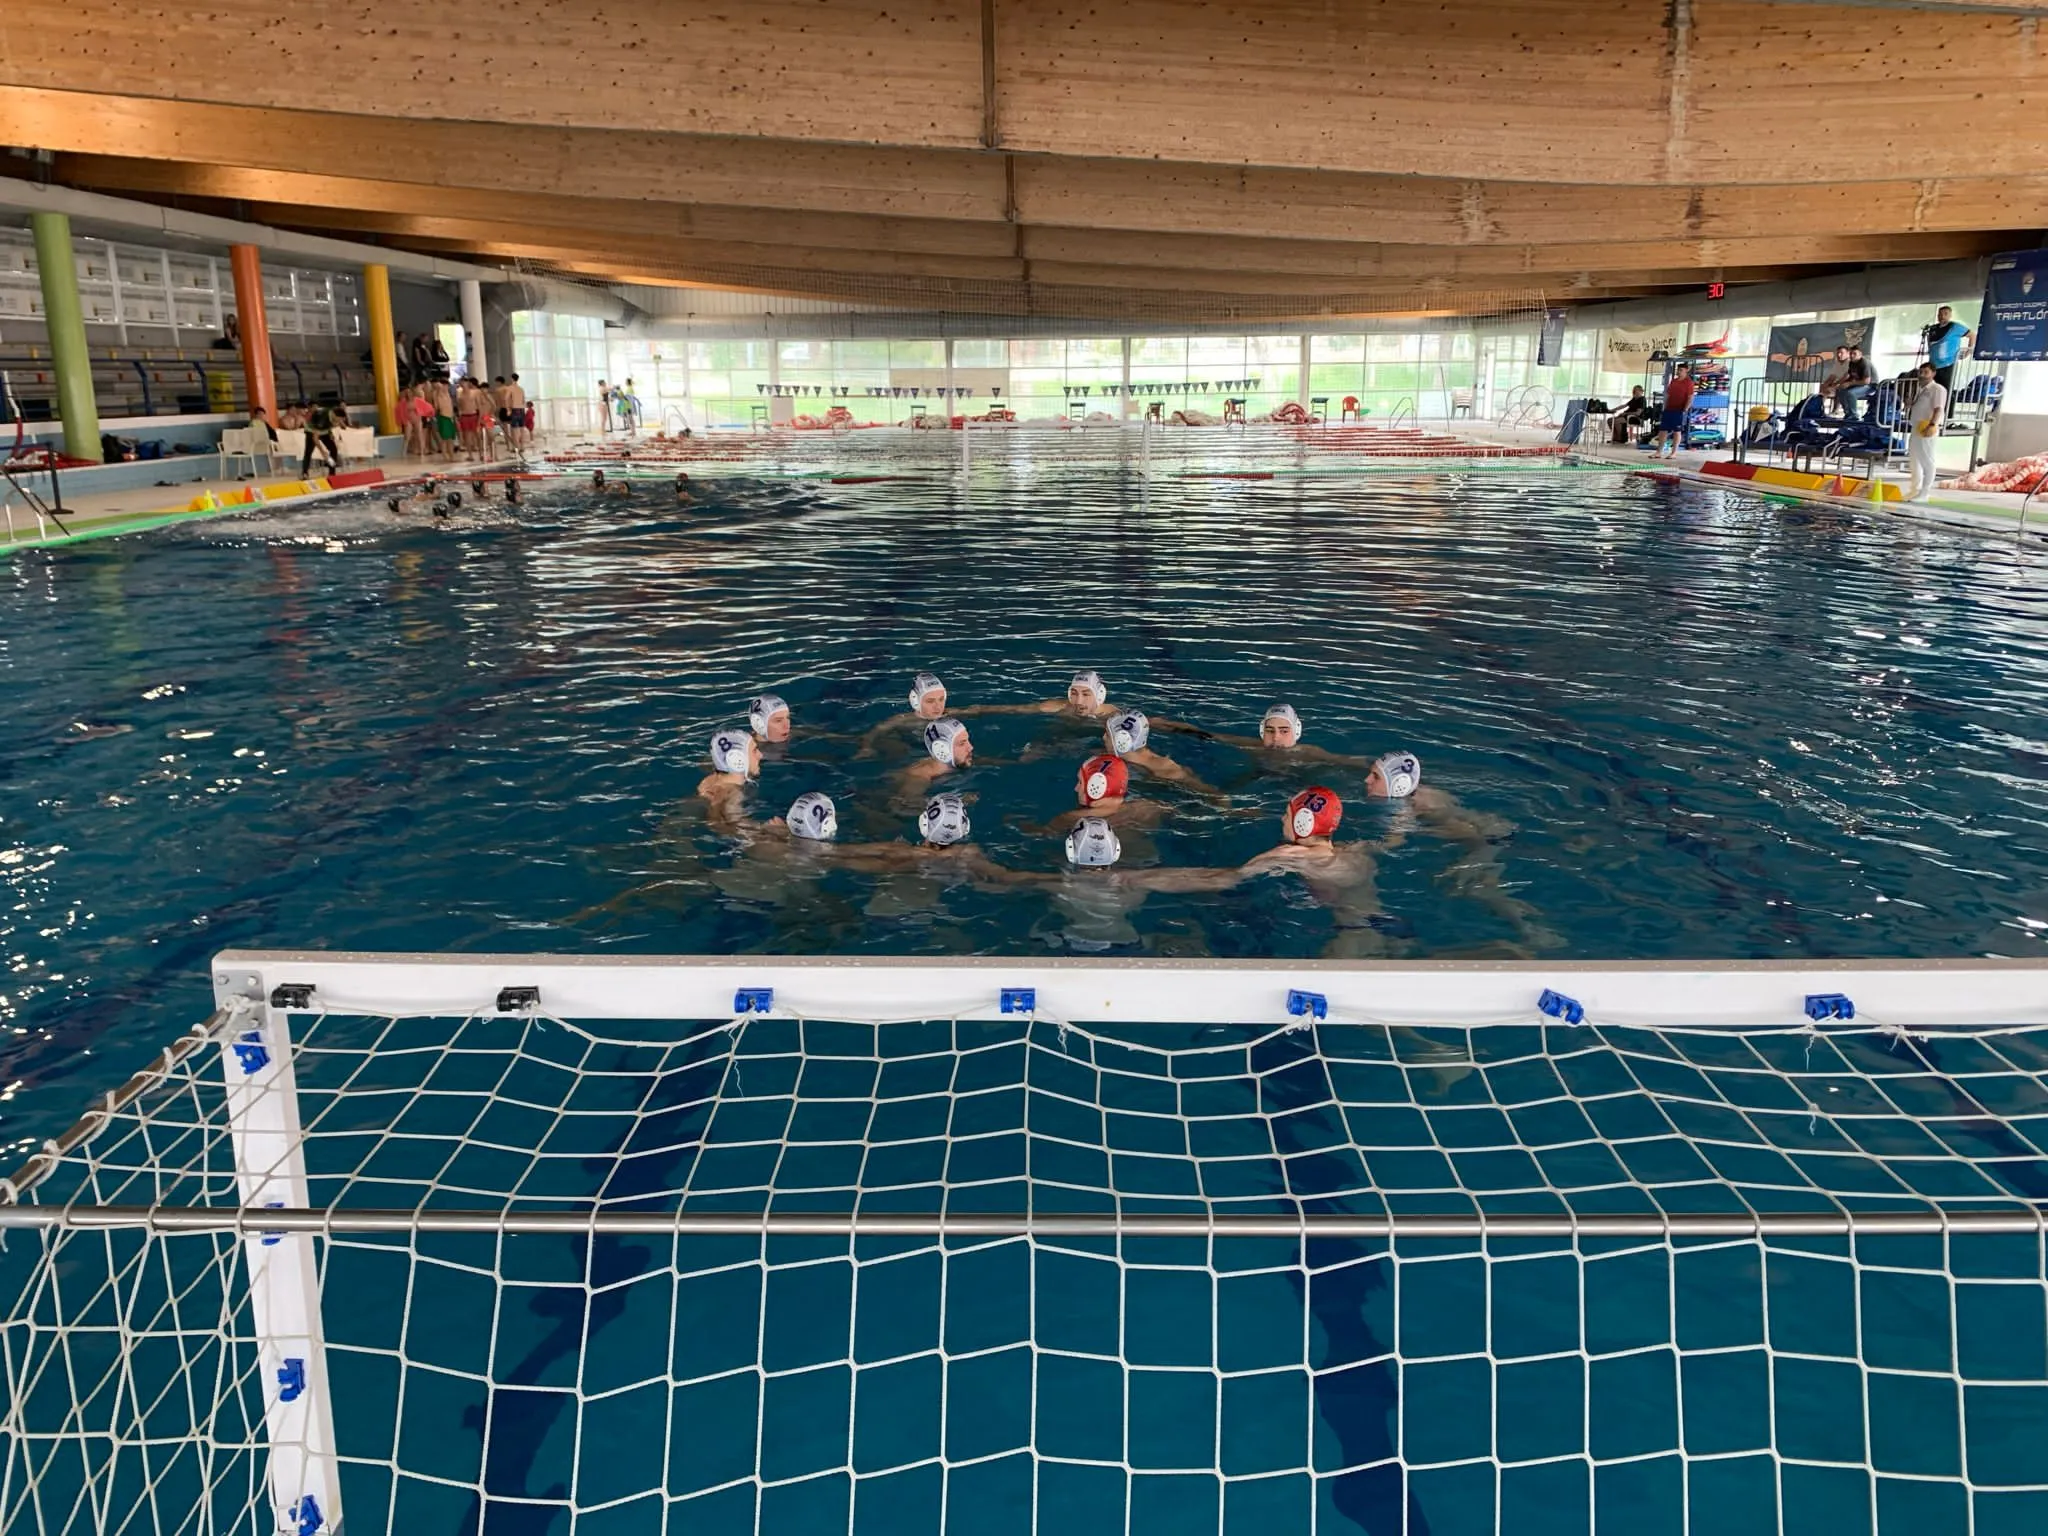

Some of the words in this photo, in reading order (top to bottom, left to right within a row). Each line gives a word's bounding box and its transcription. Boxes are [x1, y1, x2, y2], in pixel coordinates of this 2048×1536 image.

[1708, 283, 1724, 298] 30
[1121, 717, 1137, 731] 5
[926, 724, 941, 742] 11
[718, 737, 733, 753] 8
[1401, 758, 1415, 774] 3
[928, 801, 941, 820] 10
[1303, 793, 1327, 813] 13
[812, 804, 829, 823] 2
